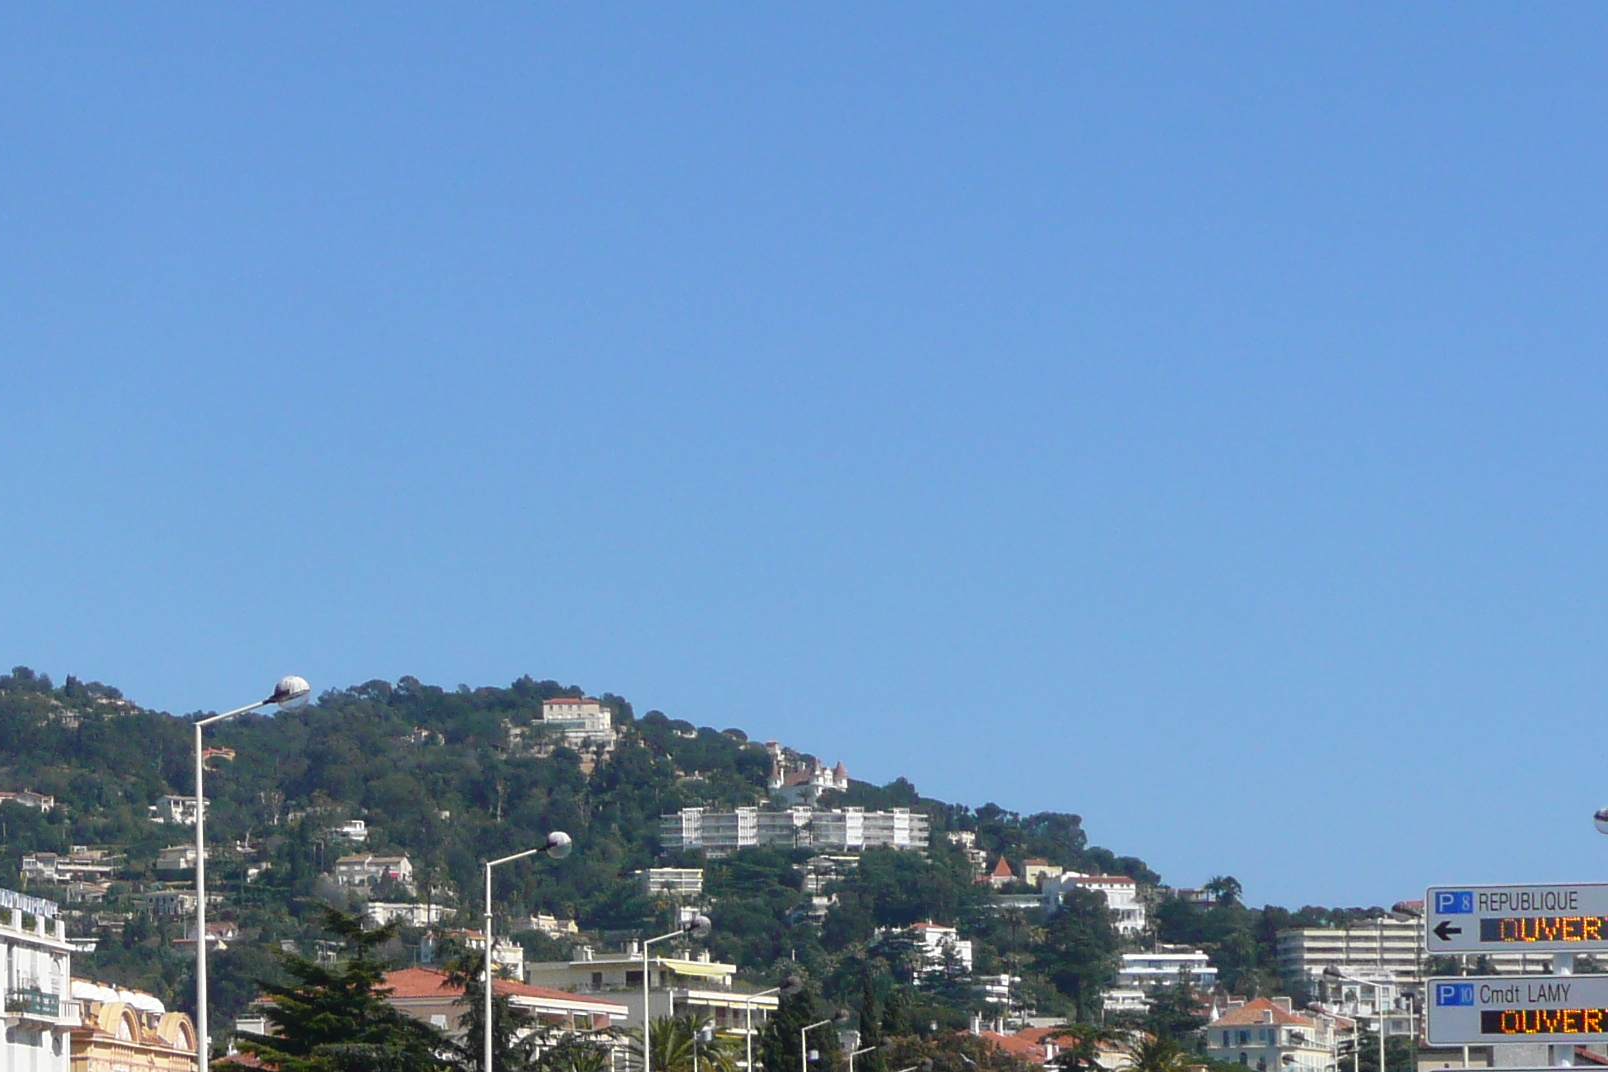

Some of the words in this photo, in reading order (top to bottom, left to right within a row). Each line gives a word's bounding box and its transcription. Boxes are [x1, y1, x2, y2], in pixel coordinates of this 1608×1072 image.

[1439, 894, 1454, 912] P
[1479, 891, 1579, 911] REPUBLIQUE
[1500, 915, 1608, 942] OUVER
[1440, 985, 1455, 1004] P
[1480, 984, 1520, 1003] Cmdt
[1528, 983, 1571, 1003] LAMY
[1501, 1008, 1608, 1035] OUVER
